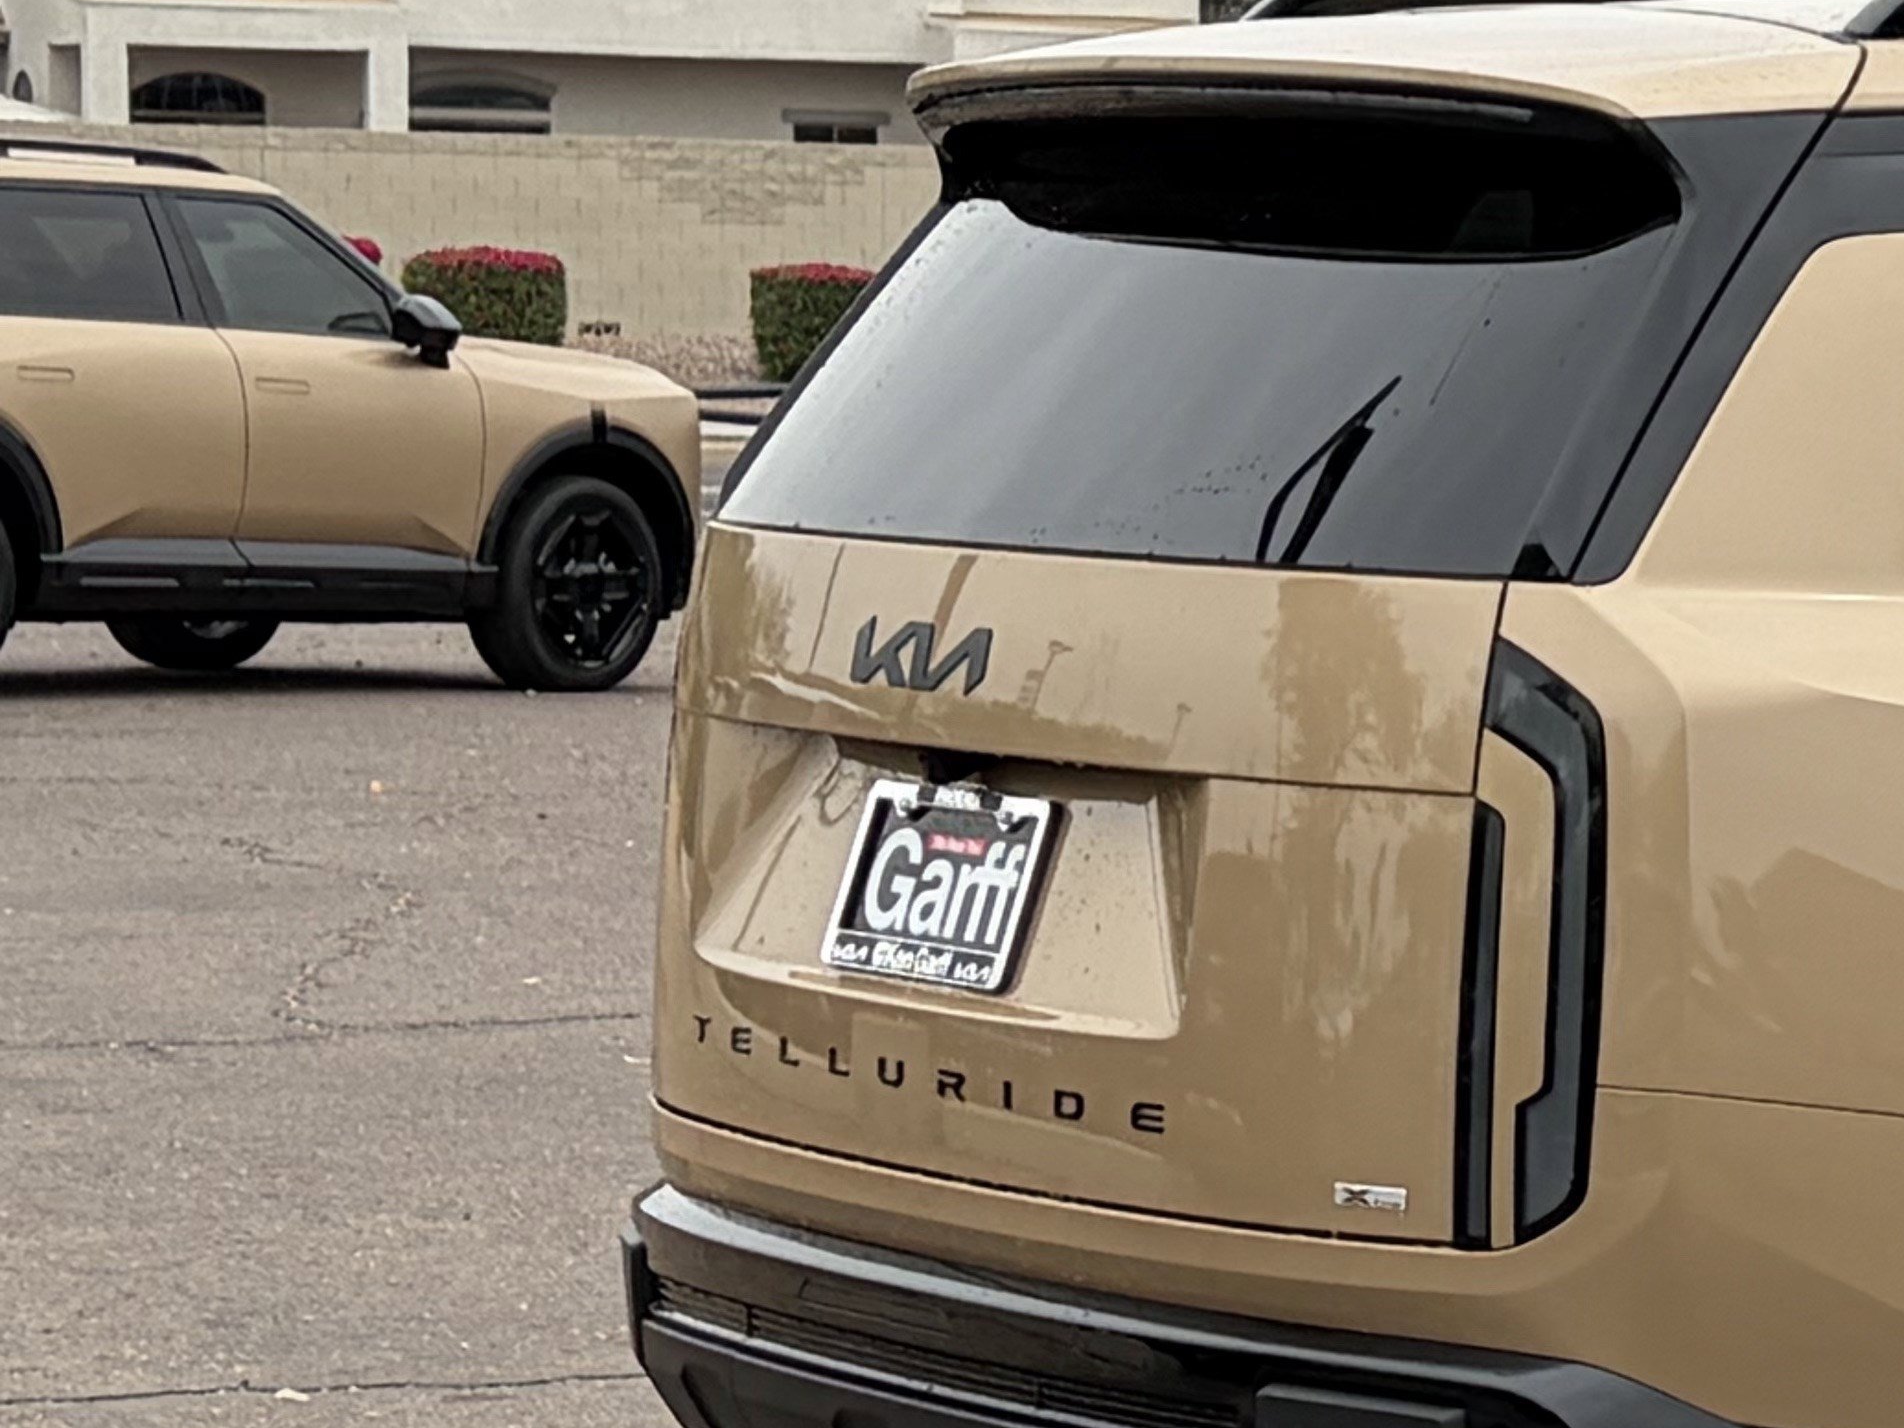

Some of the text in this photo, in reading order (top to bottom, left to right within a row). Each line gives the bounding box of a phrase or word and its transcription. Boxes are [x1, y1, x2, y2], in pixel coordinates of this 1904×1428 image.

[850, 615, 993, 697] KIA
[864, 827, 1027, 945] Garff
[692, 1014, 1167, 1135] TELLURIDE
